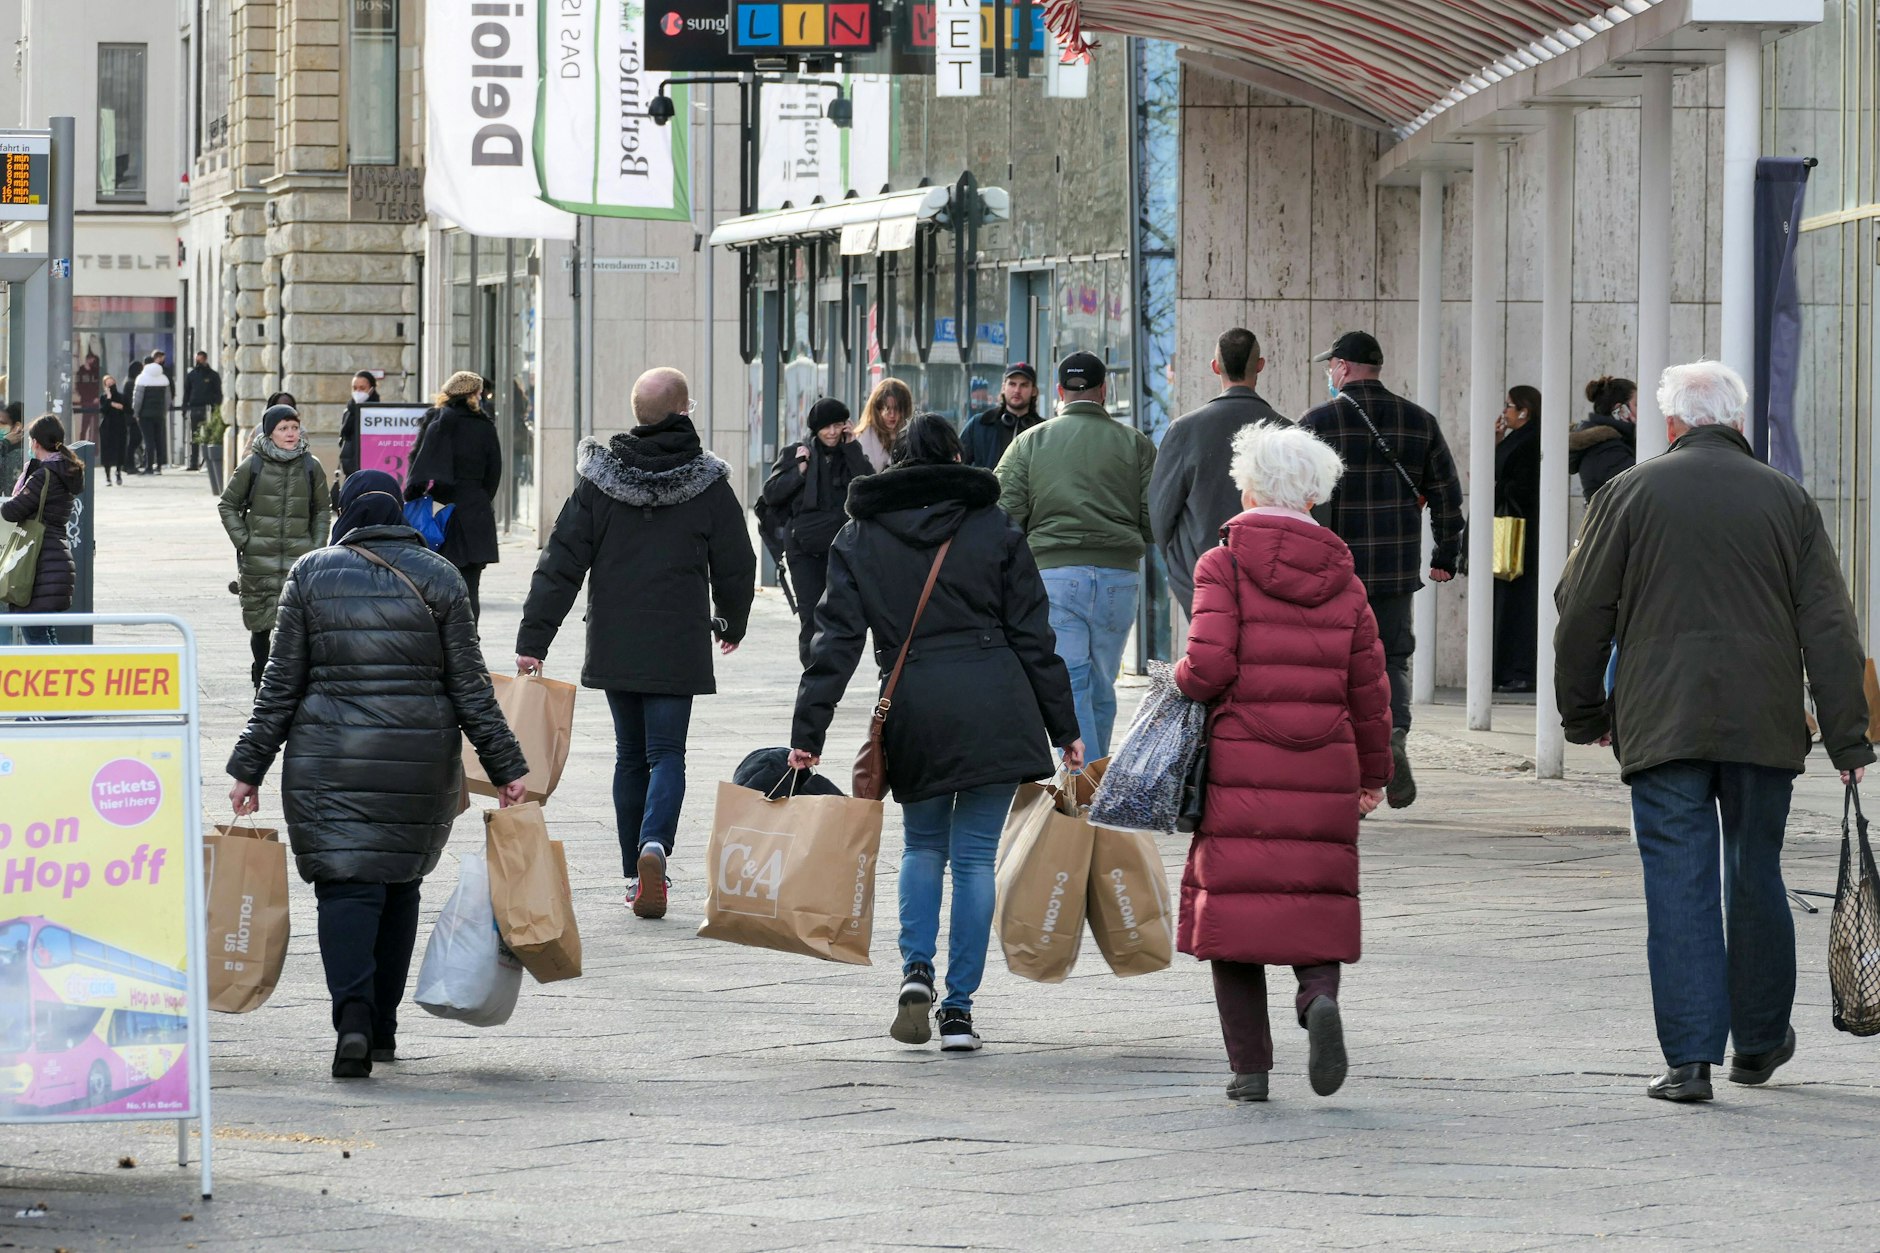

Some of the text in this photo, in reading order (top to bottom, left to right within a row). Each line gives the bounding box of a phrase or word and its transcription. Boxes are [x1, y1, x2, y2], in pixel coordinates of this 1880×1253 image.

[356, 0, 391, 11] BOSS
[749, 9, 866, 41] LIN
[948, 0, 973, 90] ET
[22, 144, 30, 152] in
[7, 153, 30, 162] 5 min
[7, 162, 30, 171] 6 min
[7, 170, 30, 179] 8 min
[7, 178, 29, 187] 9 min
[351, 167, 419, 185] URBAN
[2, 186, 29, 195] 16 min
[2, 195, 13, 203] 17
[14, 195, 29, 203] min
[352, 185, 421, 202] OUTFIT
[375, 202, 421, 220] TERS
[77, 254, 171, 269] TESLA
[650, 260, 676, 270] 21-24
[105, 668, 170, 696] HIER
[96, 780, 156, 796] Tickets
[25, 816, 80, 850] on
[3, 843, 167, 900] Hop off
[718, 843, 782, 900] C&A
[851, 853, 867, 917] C-A.COM
[1041, 871, 1069, 933] C-A.COM
[1110, 868, 1137, 930] C-A.COM
[237, 894, 254, 954] FOLLOW
[224, 933, 237, 953] US
